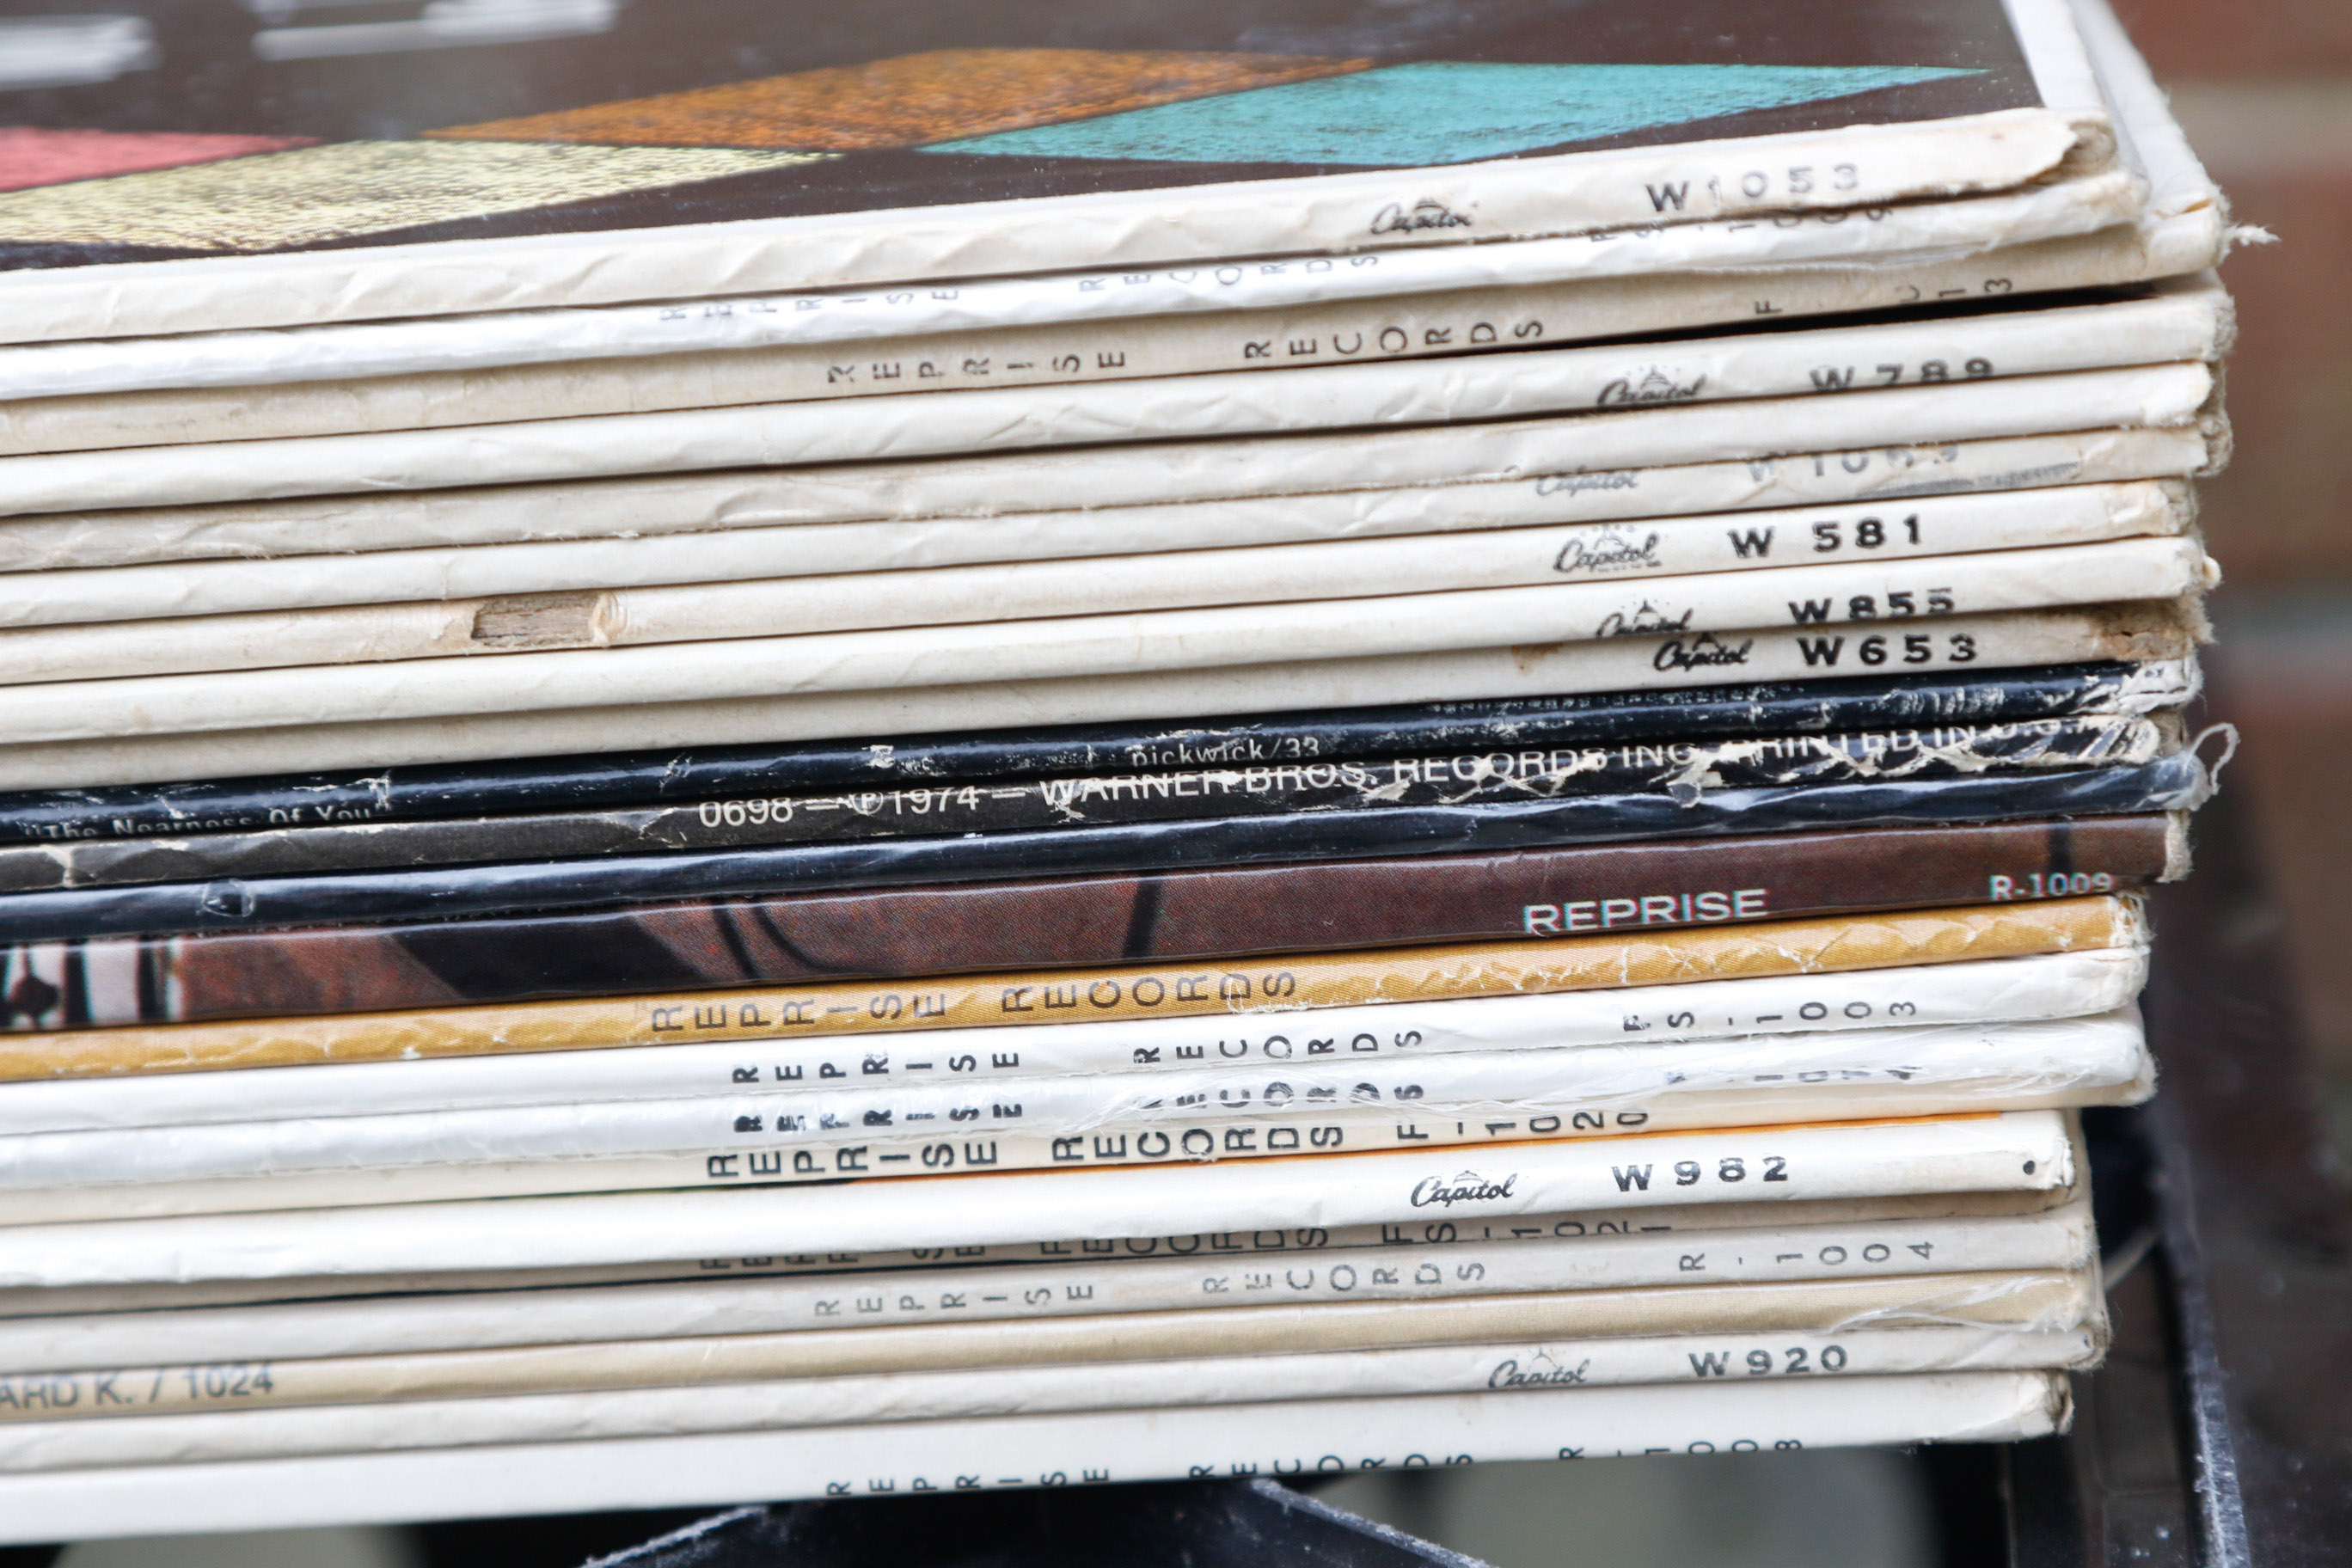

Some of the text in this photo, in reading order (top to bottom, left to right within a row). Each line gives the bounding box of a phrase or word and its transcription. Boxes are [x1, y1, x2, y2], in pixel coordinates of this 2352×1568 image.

[1645, 181, 1688, 212] W
[659, 255, 1379, 321] REPRISE RECORDS
[827, 352, 1127, 384] REPRISE
[1245, 320, 1543, 359] RECORDS
[1597, 356, 1994, 407] Capitol W 789
[1553, 513, 1921, 573] Capitol W 581
[1596, 587, 1956, 638] Capitol W 855
[1653, 632, 1977, 672] Capitol W 653
[698, 796, 794, 828] 0698
[1038, 765, 1230, 805] WARNER
[1393, 746, 1608, 783] RECORDS
[1522, 871, 2116, 935] REPRISE R-1009
[652, 971, 1296, 1032] REPRISE RECORDS
[732, 1051, 1020, 1083] REPRISE
[1133, 1030, 1423, 1063] RECORDS
[733, 1103, 1022, 1132] REPRISE
[707, 1111, 1649, 1179] REPRISE RECORDS F-1020
[1411, 1155, 1790, 1207] Capitol W 982
[815, 1240, 1935, 1316] REPRISE RECORDS R-1004
[95, 1373, 133, 1405] K.
[181, 1364, 273, 1400] 1024
[1487, 1344, 1848, 1388] Capitol W 920
[826, 1467, 1109, 1498] REPRISE
